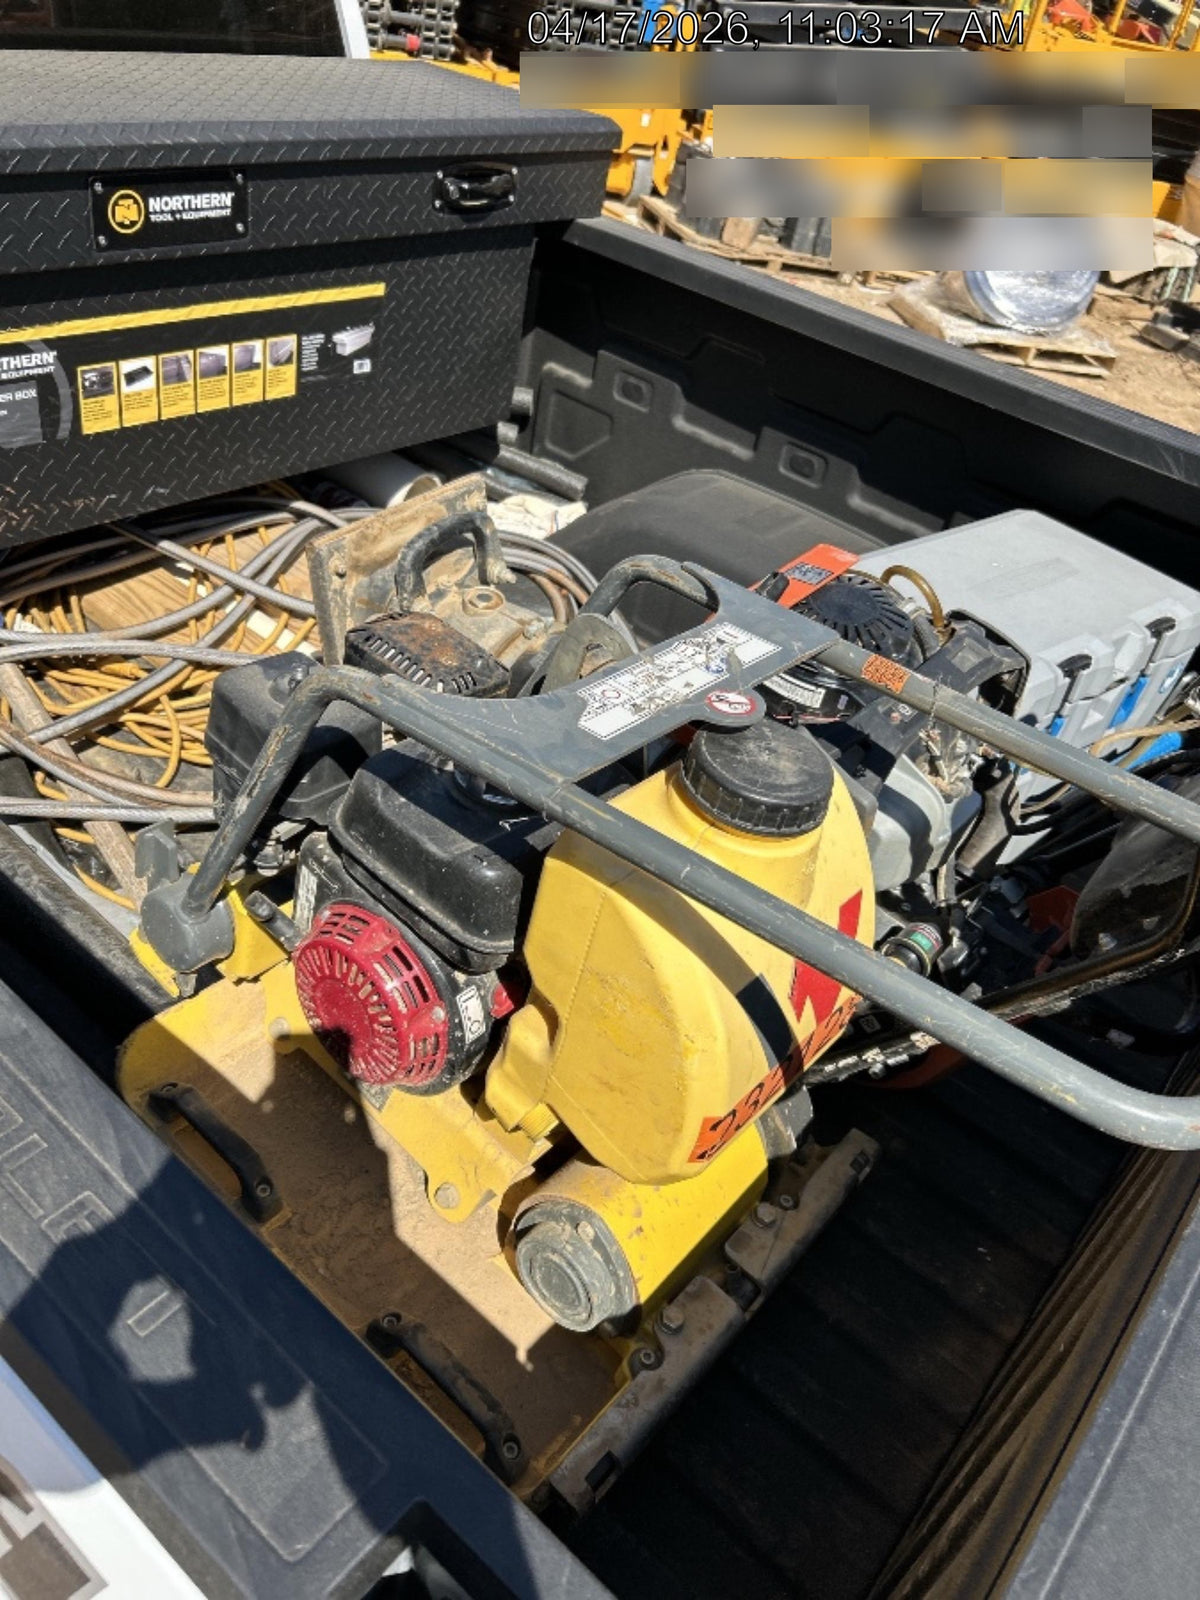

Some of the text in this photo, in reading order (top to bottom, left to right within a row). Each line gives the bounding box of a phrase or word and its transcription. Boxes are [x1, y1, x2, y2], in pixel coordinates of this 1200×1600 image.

[149, 192, 232, 212] NORTHERN
[149, 213, 173, 221] TOOL
[182, 208, 231, 219] EQUIPMENT
[0, 352, 54, 371] THERN
[15, 389, 37, 400] BOX
